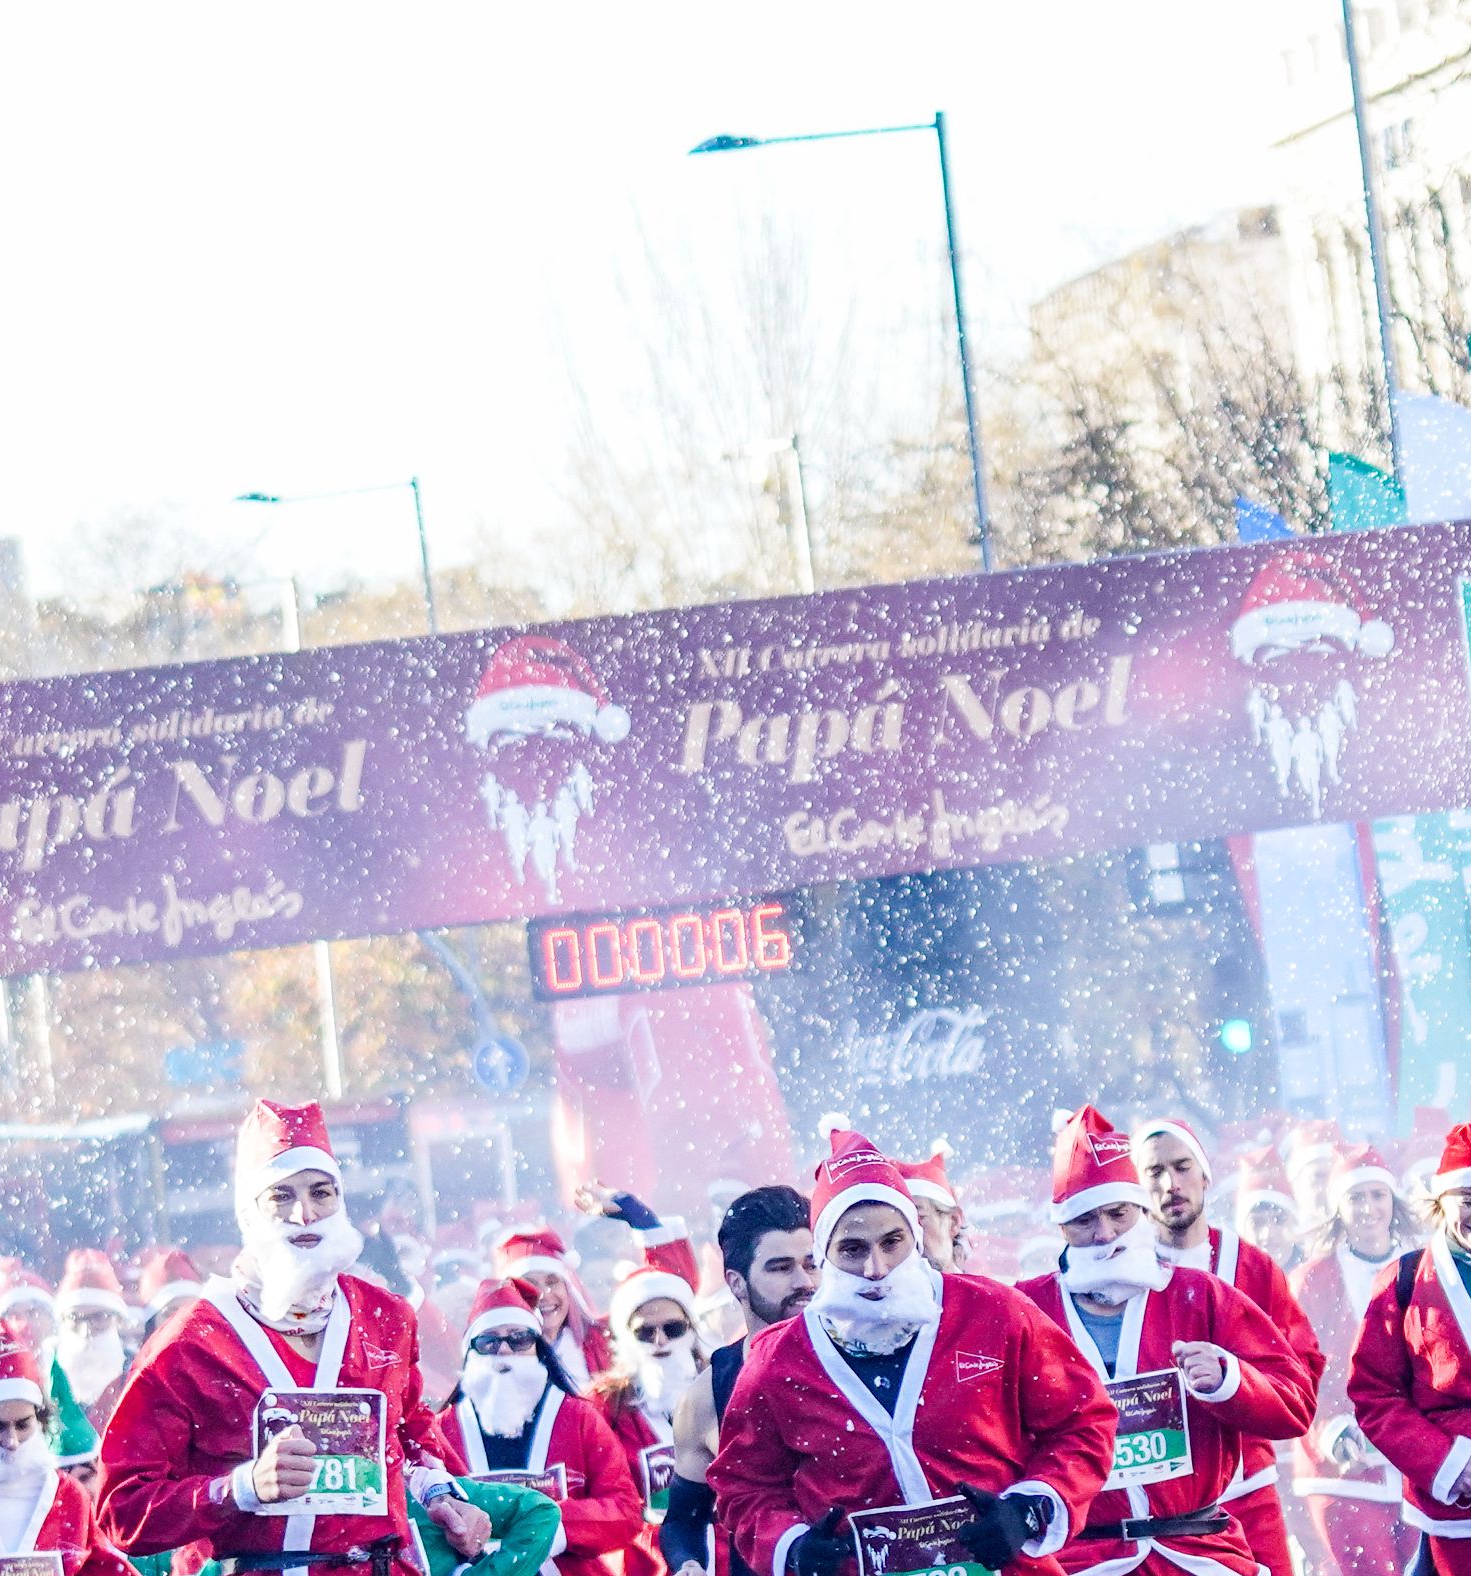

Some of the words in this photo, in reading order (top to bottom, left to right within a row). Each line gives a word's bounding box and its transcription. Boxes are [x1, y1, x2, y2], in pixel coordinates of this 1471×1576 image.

[1061, 609, 1102, 640] de
[293, 697, 335, 726] de
[679, 679, 907, 784] Papá
[934, 654, 1134, 745] Noel
[166, 739, 367, 833] Noel
[785, 809, 828, 858] El
[829, 806, 928, 852] Corte
[931, 789, 1070, 859] Inglés
[61, 894, 160, 940] Corte
[159, 873, 304, 947] Inglés
[1114, 1393, 1139, 1411] apá
[1142, 1386, 1172, 1403] Noel
[299, 1409, 336, 1427] Papá
[897, 1520, 935, 1542] Papá
